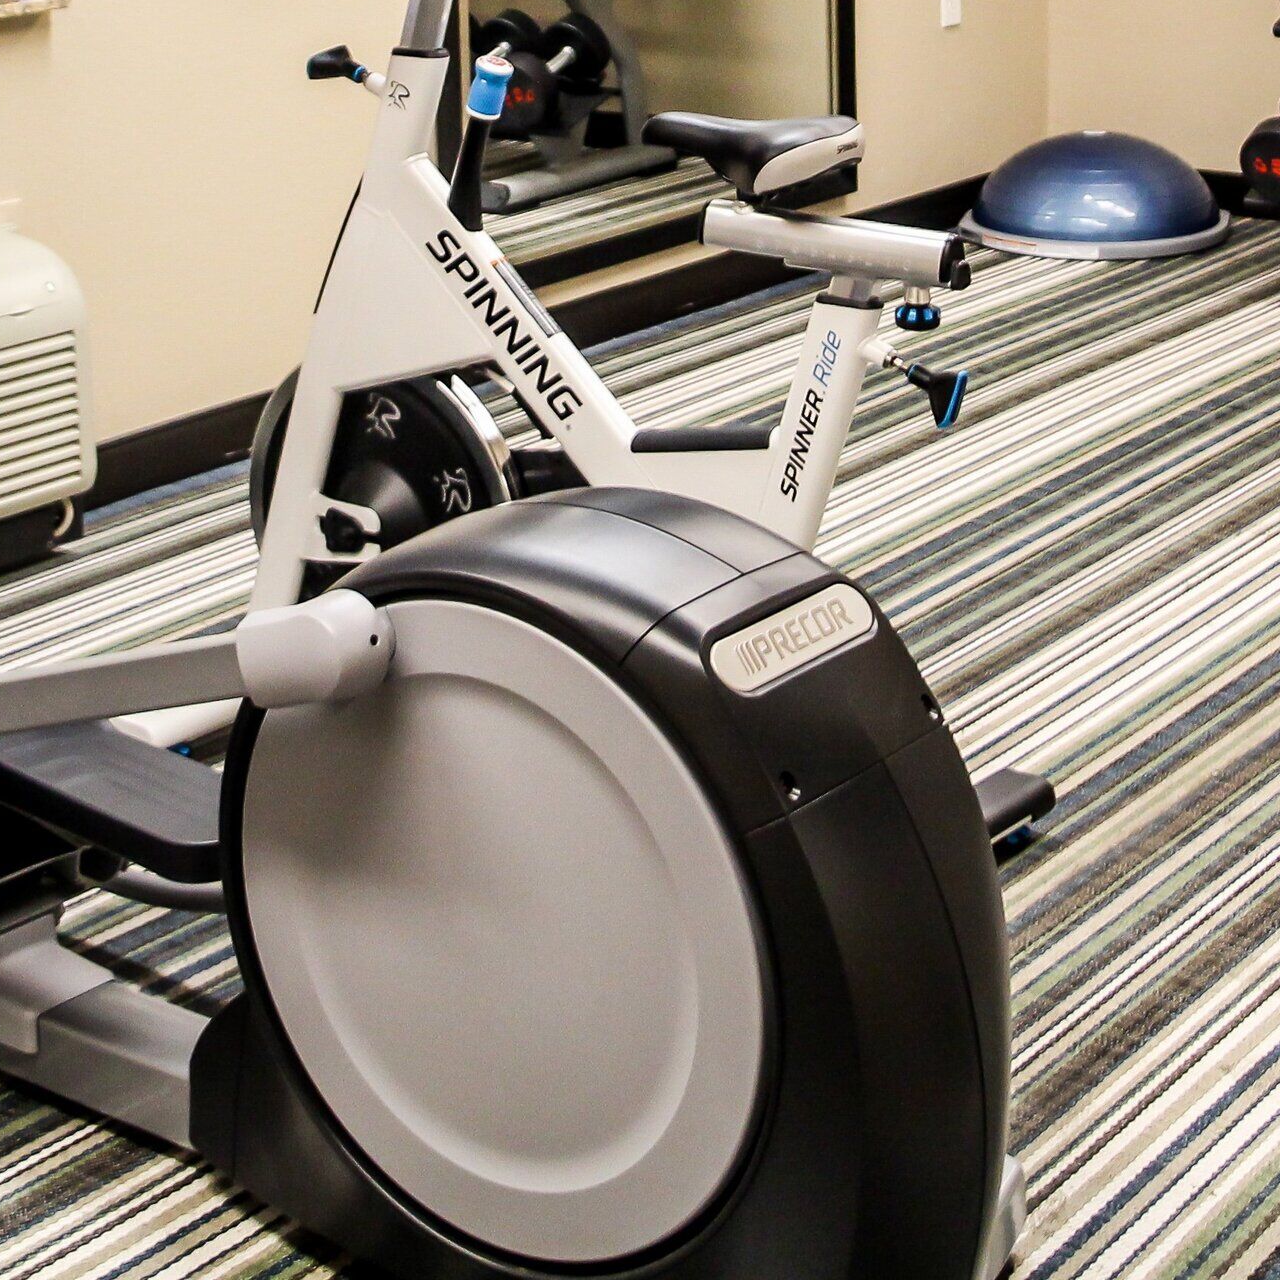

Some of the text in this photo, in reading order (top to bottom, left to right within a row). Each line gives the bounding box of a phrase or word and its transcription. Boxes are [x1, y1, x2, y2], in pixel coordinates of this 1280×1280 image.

[425, 229, 584, 421] SPINNING
[780, 329, 842, 503] SPINNER Ride
[750, 596, 854, 671] PRECOR
